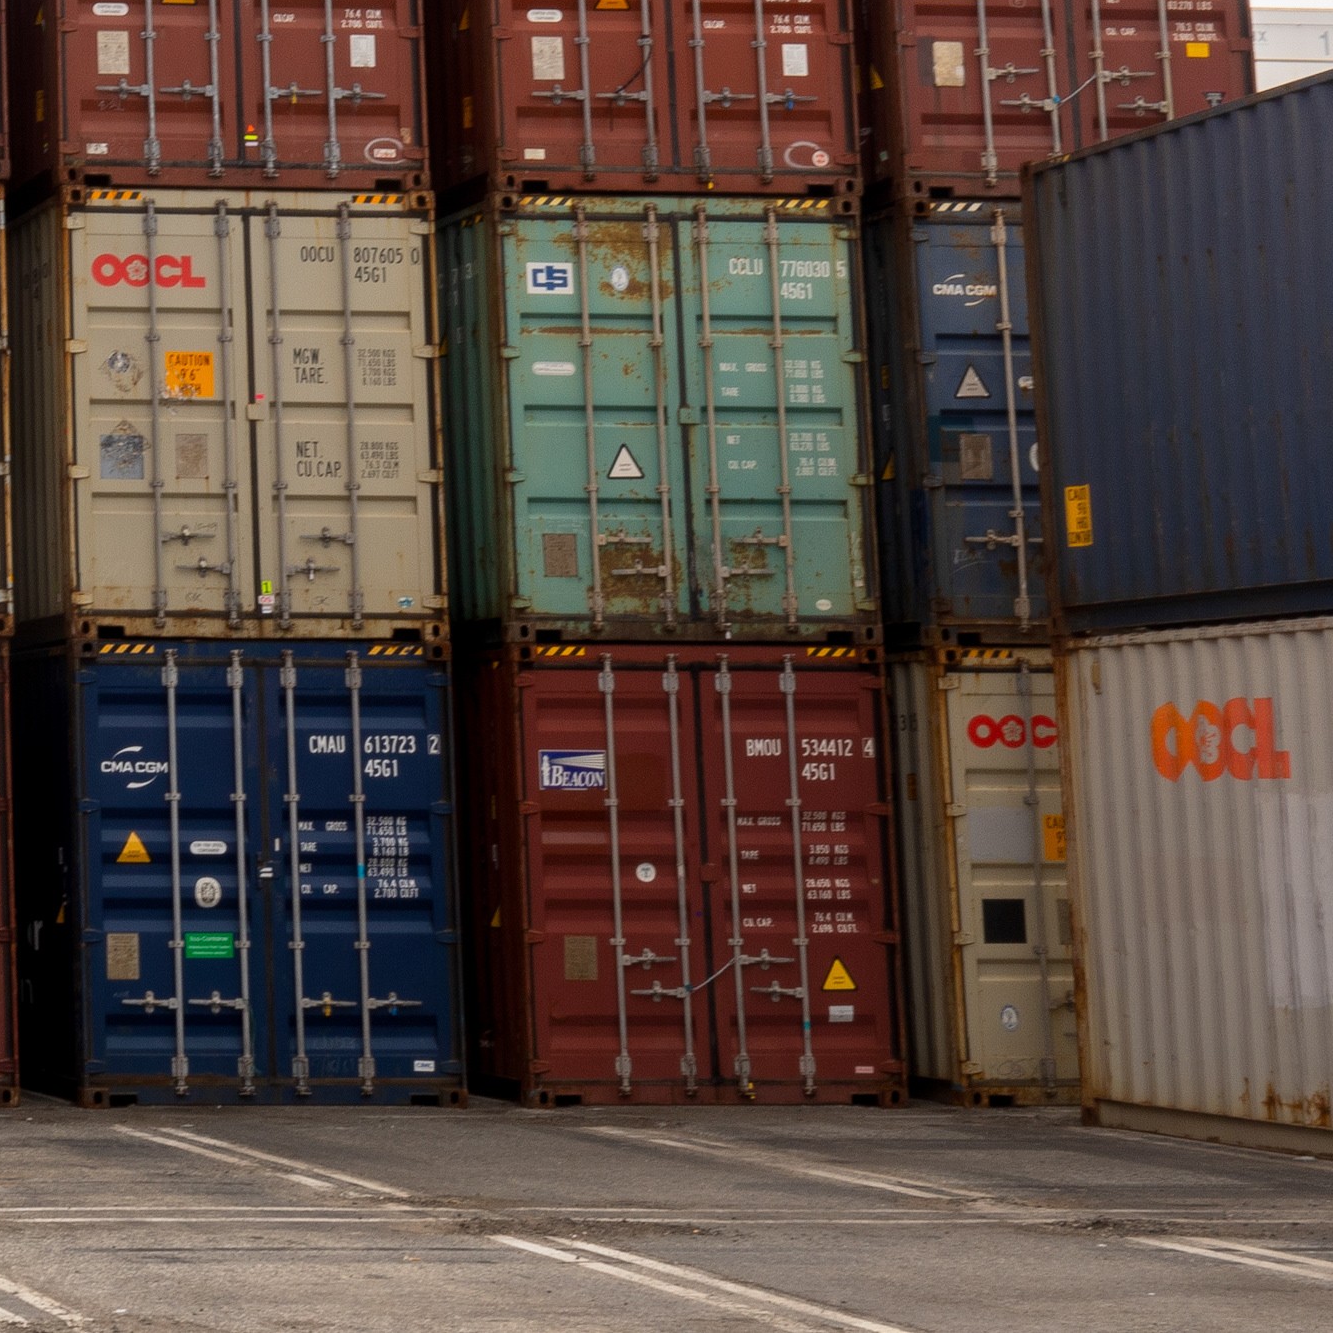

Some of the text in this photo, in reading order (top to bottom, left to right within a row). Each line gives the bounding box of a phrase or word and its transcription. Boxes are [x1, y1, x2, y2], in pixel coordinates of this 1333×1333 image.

[301, 246, 419, 265] OOCU 807605 0
[91, 254, 205, 288] OOCL
[355, 267, 386, 284] 45G1
[729, 258, 846, 277] CCLU 776030 5
[781, 283, 813, 299] 45G1
[168, 354, 210, 367] CAUTION
[293, 348, 324, 364] MGW.
[294, 367, 328, 384] TARE.
[297, 441, 323, 458] NET.
[263, 582, 272, 593] 1
[968, 714, 1058, 748] OOC
[1150, 697, 1291, 781] OOCL
[309, 736, 438, 753] CMAU 613723 2
[746, 739, 874, 756] BMOU 534412 4
[365, 760, 398, 777] 45G1
[551, 767, 604, 787] BEACON
[802, 763, 835, 781] 45G1
